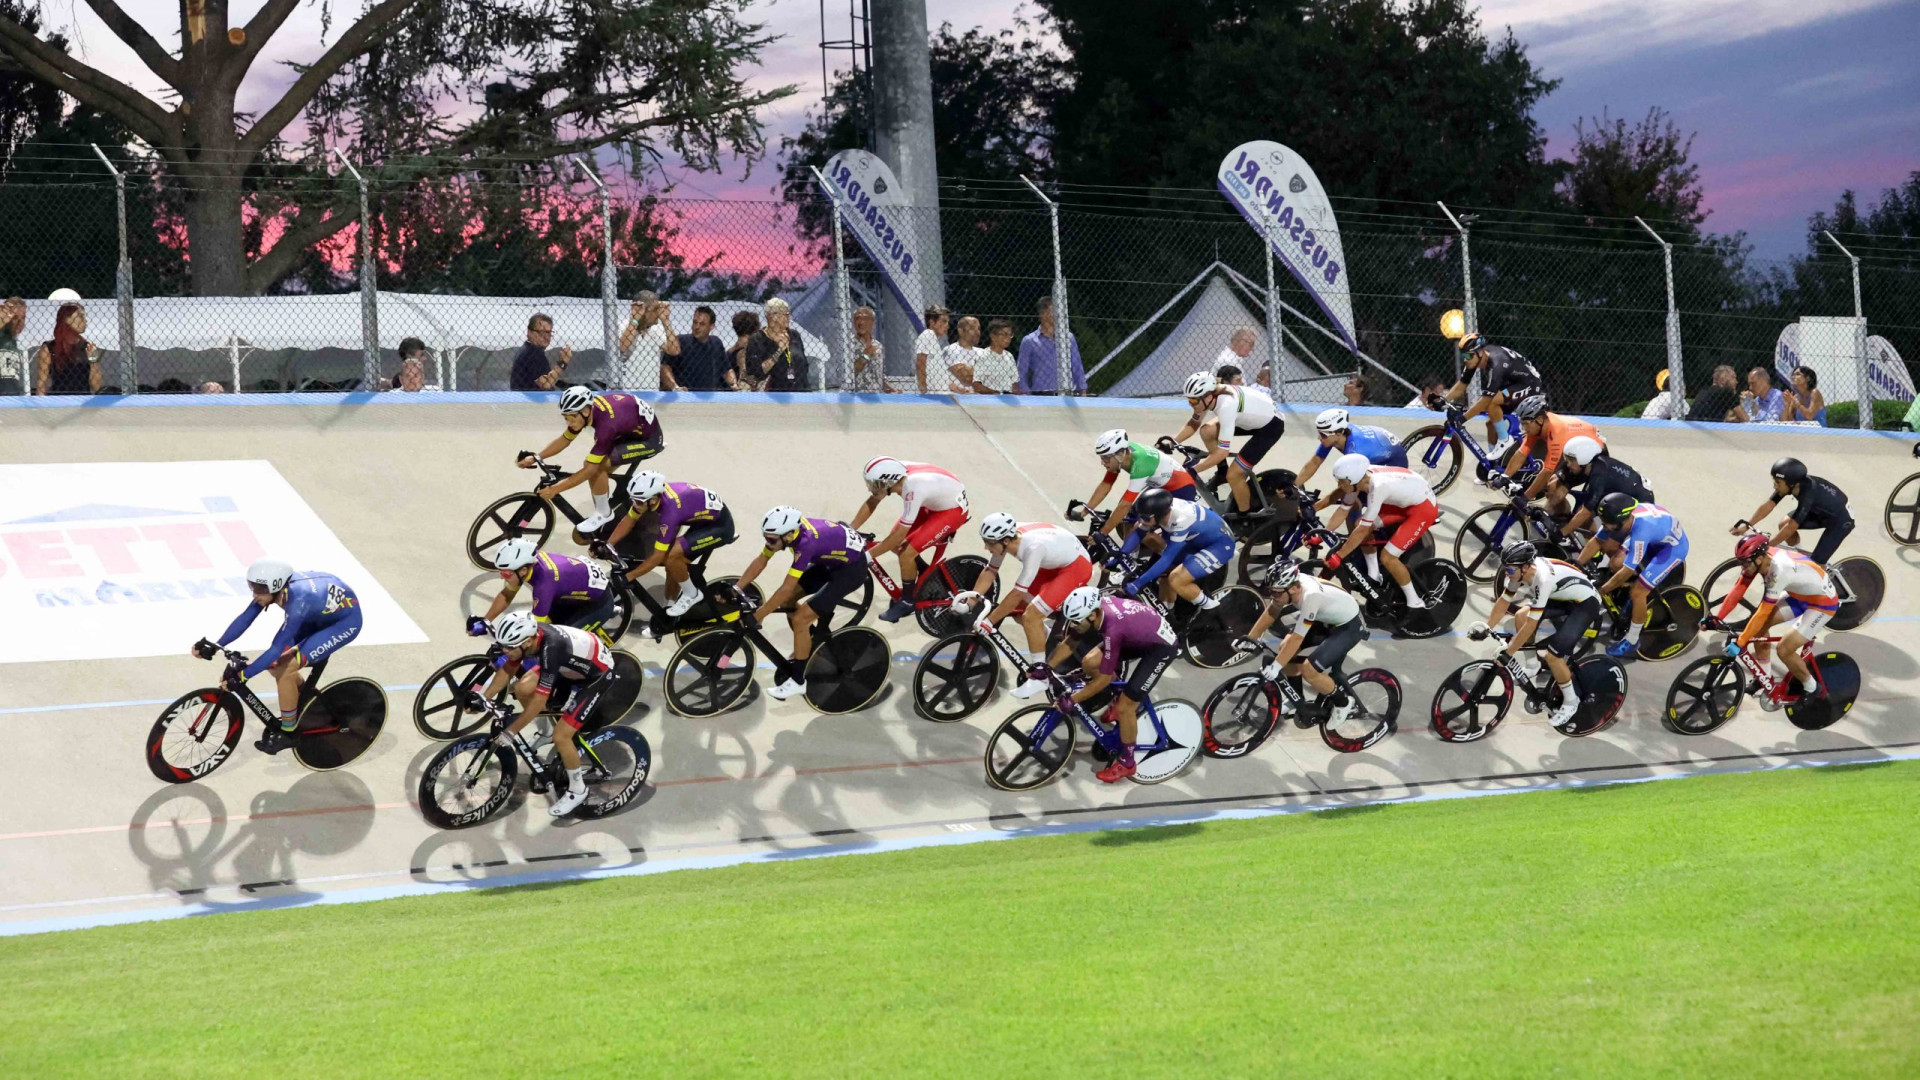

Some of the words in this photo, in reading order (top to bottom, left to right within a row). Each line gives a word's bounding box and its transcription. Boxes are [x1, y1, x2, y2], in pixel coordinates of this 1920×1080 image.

[1512, 386, 1532, 400] CTF
[0, 519, 267, 580] ETTI
[1403, 521, 1427, 549] POLSKA
[272, 577, 283, 591] 90
[328, 584, 343, 604] 48
[1346, 562, 1371, 591] ARGON
[1367, 588, 1379, 600] 18
[1143, 587, 1168, 617] DOLAN
[309, 626, 358, 660] ROMÂNIA
[994, 633, 1022, 663] ARGON
[1141, 673, 1158, 691] FIAMME
[1154, 662, 1166, 675] ORO
[1742, 654, 1774, 692] cervélo
[1279, 679, 1300, 702] FES
[245, 693, 272, 722] SUPERCOM
[580, 693, 600, 721] LOOK
[1074, 703, 1105, 738] PINARELLO
[515, 735, 544, 774] FUJI
[1136, 746, 1196, 780] CAMPAGNOL
